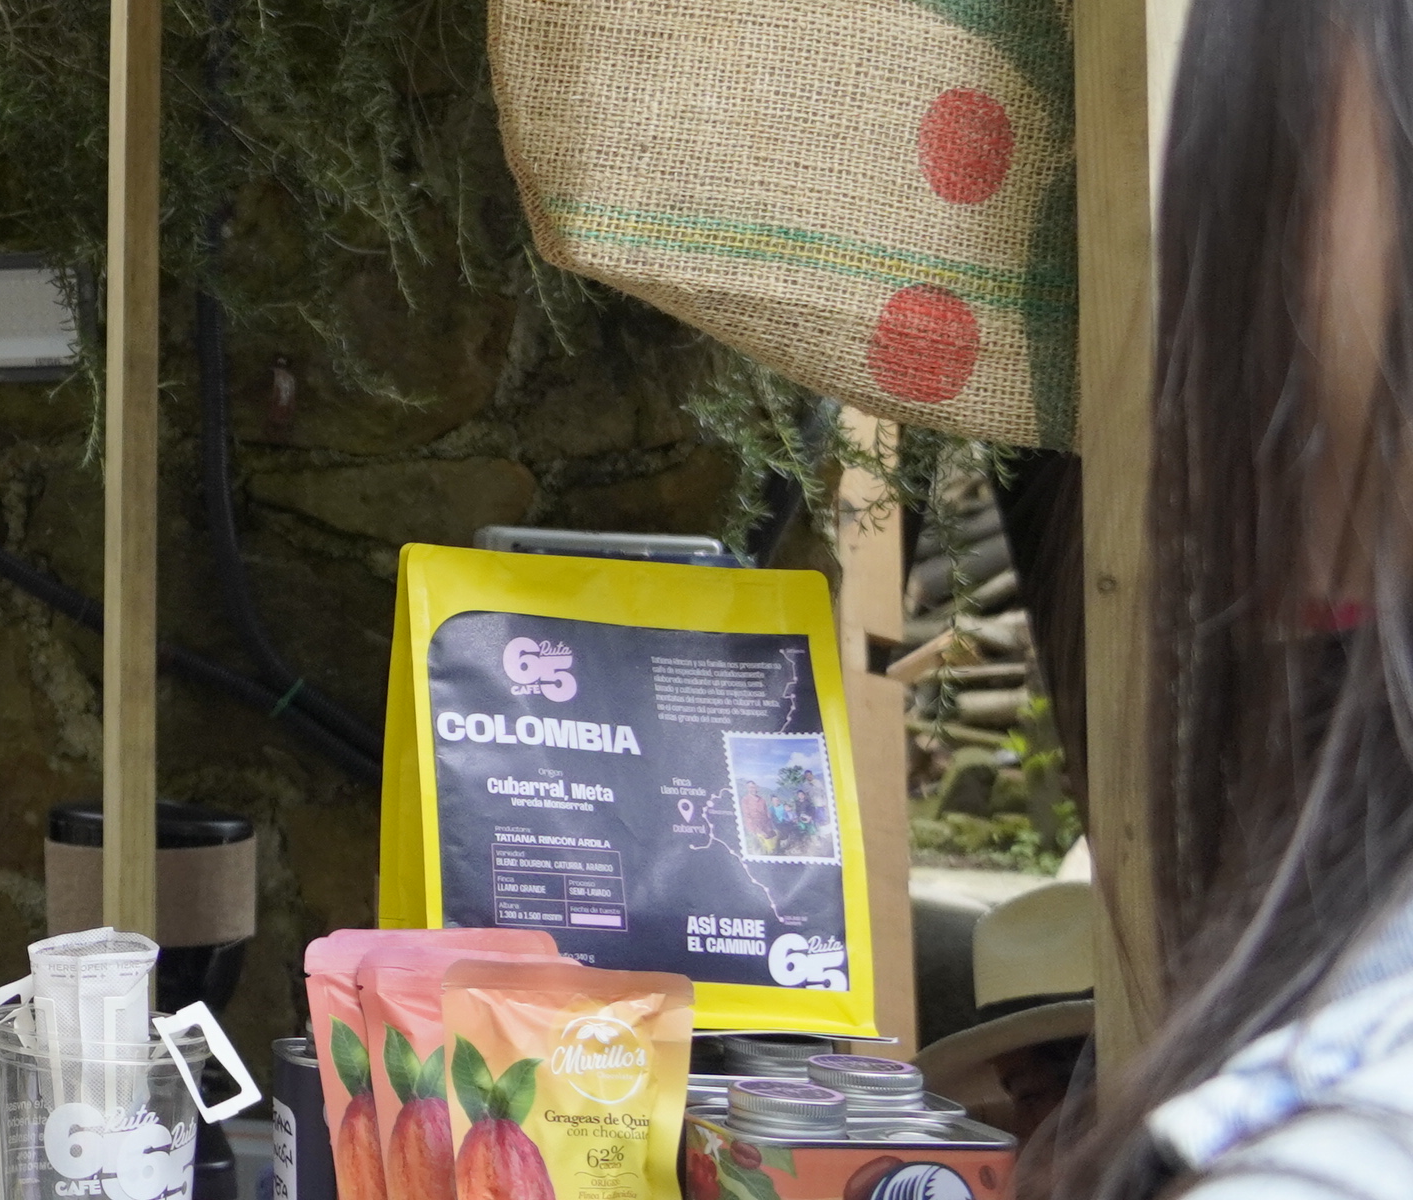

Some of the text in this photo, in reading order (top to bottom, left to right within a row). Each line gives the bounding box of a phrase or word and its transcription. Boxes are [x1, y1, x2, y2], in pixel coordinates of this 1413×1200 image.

[539, 640, 572, 656] Ruta
[503, 637, 577, 702] 65
[437, 711, 641, 755] COLOMBIA
[487, 776, 614, 802] Cubarral, Meta
[494, 833, 536, 844] TATIANA
[687, 914, 716, 936] ASÍ
[719, 917, 765, 938] SABE
[687, 936, 766, 956] EL CAMINO
[807, 935, 844, 954] Ruta
[768, 933, 847, 992] 65
[551, 1045, 646, 1075] Murillo's
[544, 1109, 600, 1128] Grageas
[604, 1112, 620, 1126] de
[567, 1126, 588, 1137] con
[586, 1145, 625, 1168] 62%
[54, 1174, 102, 1196] CAFÉ
